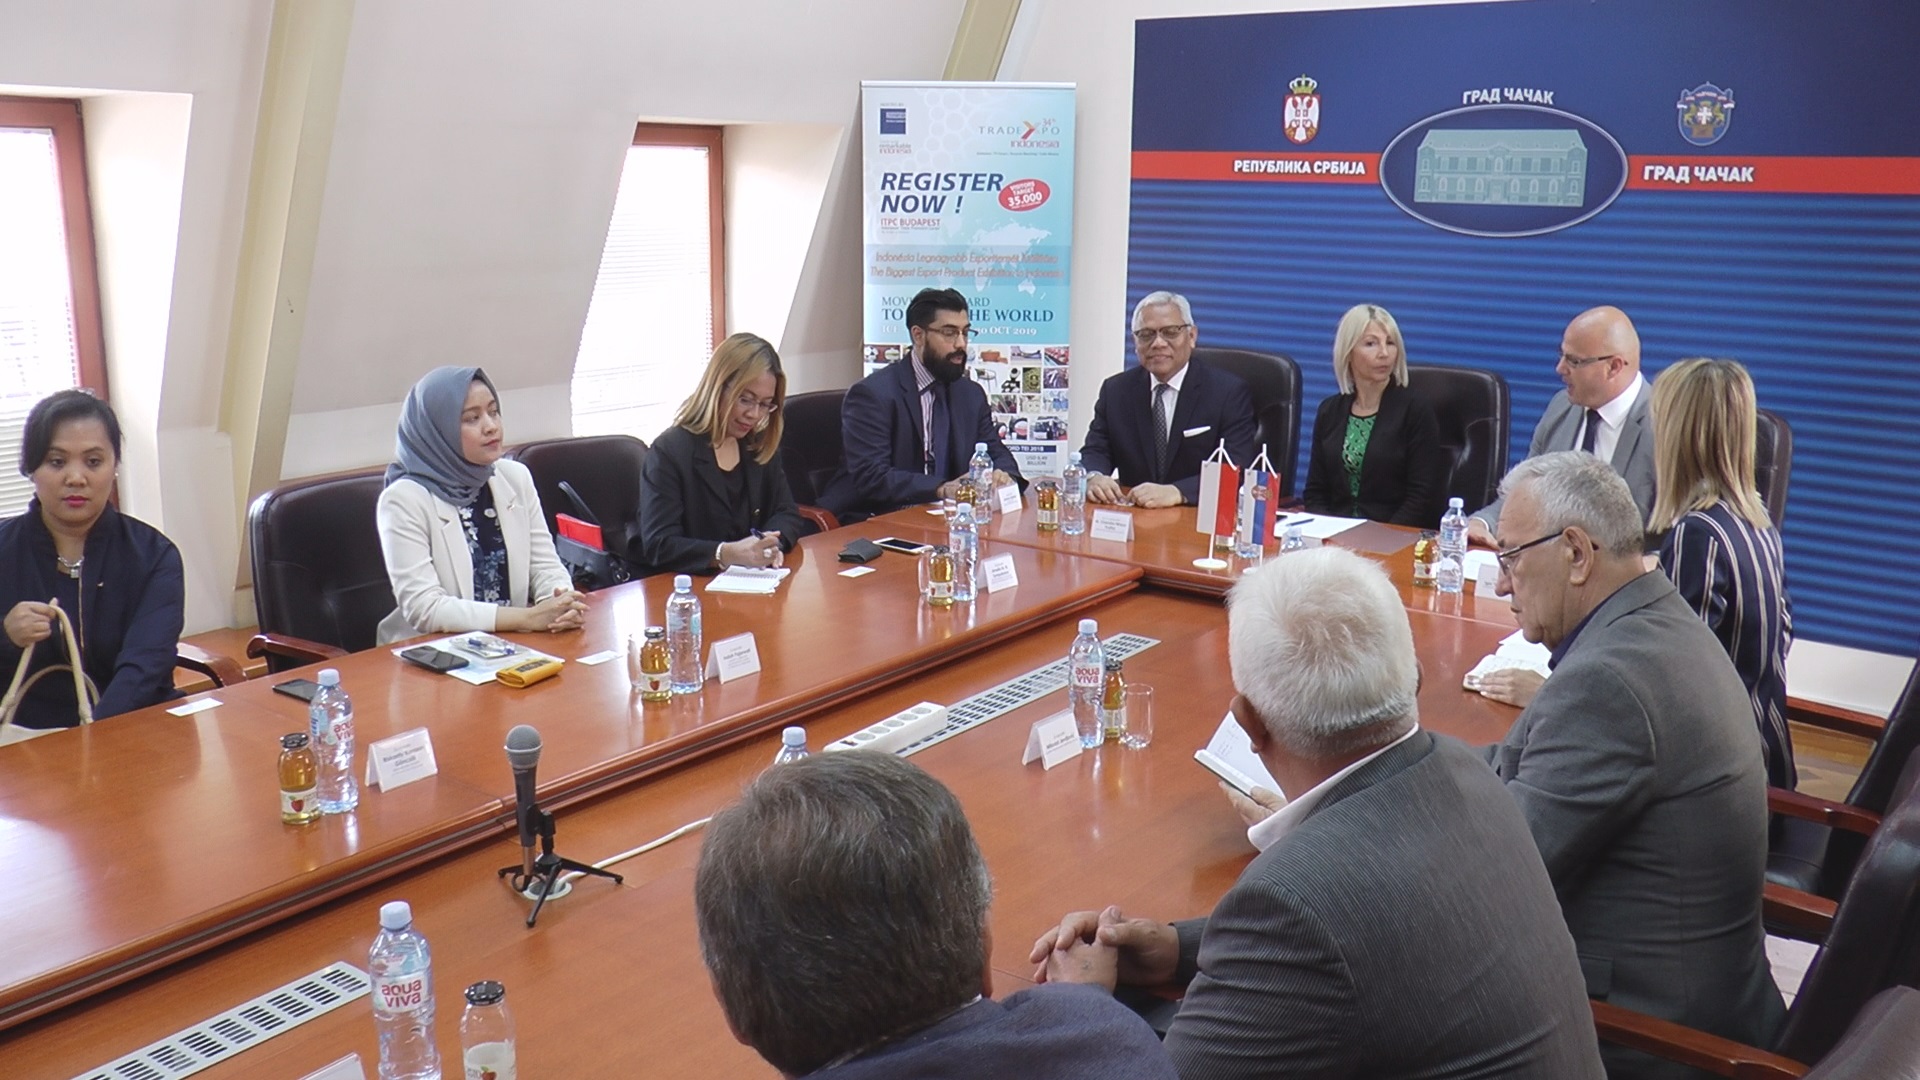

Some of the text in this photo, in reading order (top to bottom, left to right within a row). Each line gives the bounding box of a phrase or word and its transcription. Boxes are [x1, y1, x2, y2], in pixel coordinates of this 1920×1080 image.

[1462, 87, 1554, 105] ГРАД ЧАЧАК
[1233, 159, 1366, 175] РЕПУБЛИКА СРБИЈА
[1643, 165, 1755, 184] ГРАД ЧАЧАК
[880, 172, 1004, 191] REGISTER
[880, 194, 947, 213] NOW
[1007, 192, 1043, 207] 35.000
[880, 218, 941, 227] ITPC BUDAPEST
[870, 266, 884, 276] The
[886, 266, 915, 278] Biggest
[917, 266, 942, 278] Export
[944, 267, 975, 277] Product
[969, 309, 991, 321] HE
[995, 309, 1054, 322] WORLD
[989, 326, 1010, 334] OCT
[1013, 327, 1037, 336] 2019
